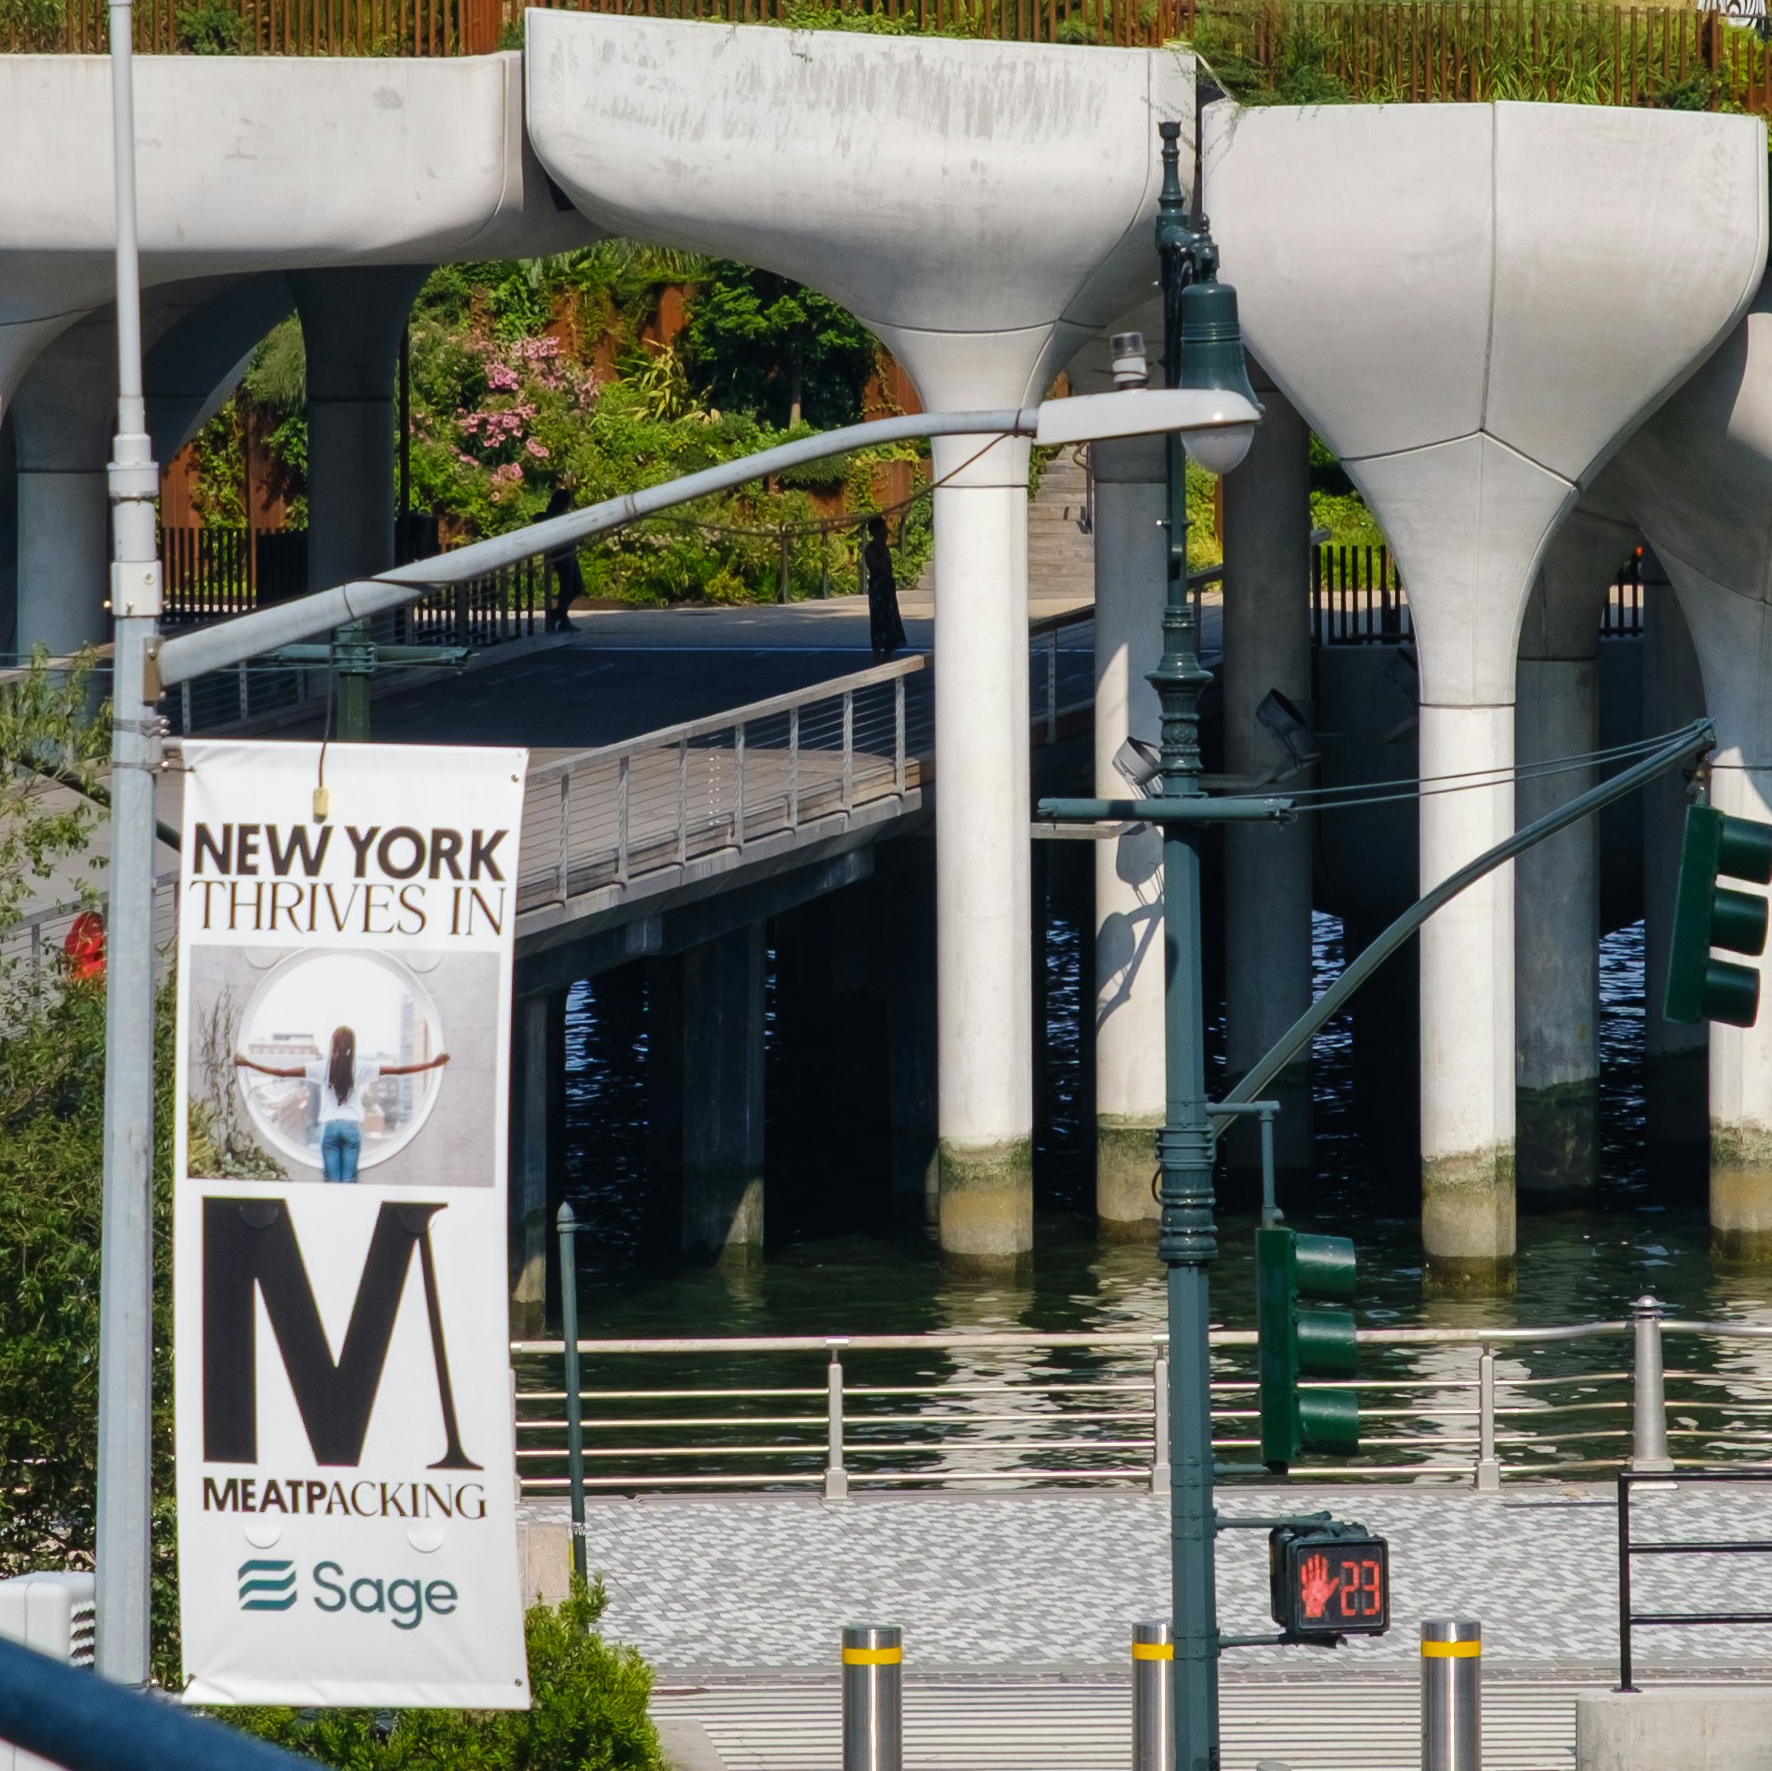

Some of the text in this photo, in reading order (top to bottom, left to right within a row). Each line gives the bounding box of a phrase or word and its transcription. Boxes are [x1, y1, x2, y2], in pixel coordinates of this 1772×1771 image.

[193, 822, 510, 881] NEW YORK
[188, 880, 507, 936] THRIVES IN
[202, 1196, 485, 1471] M
[202, 1476, 489, 1520] MEATPACKING
[312, 1560, 459, 1630] Sage
[1340, 1560, 1381, 1617] 23
